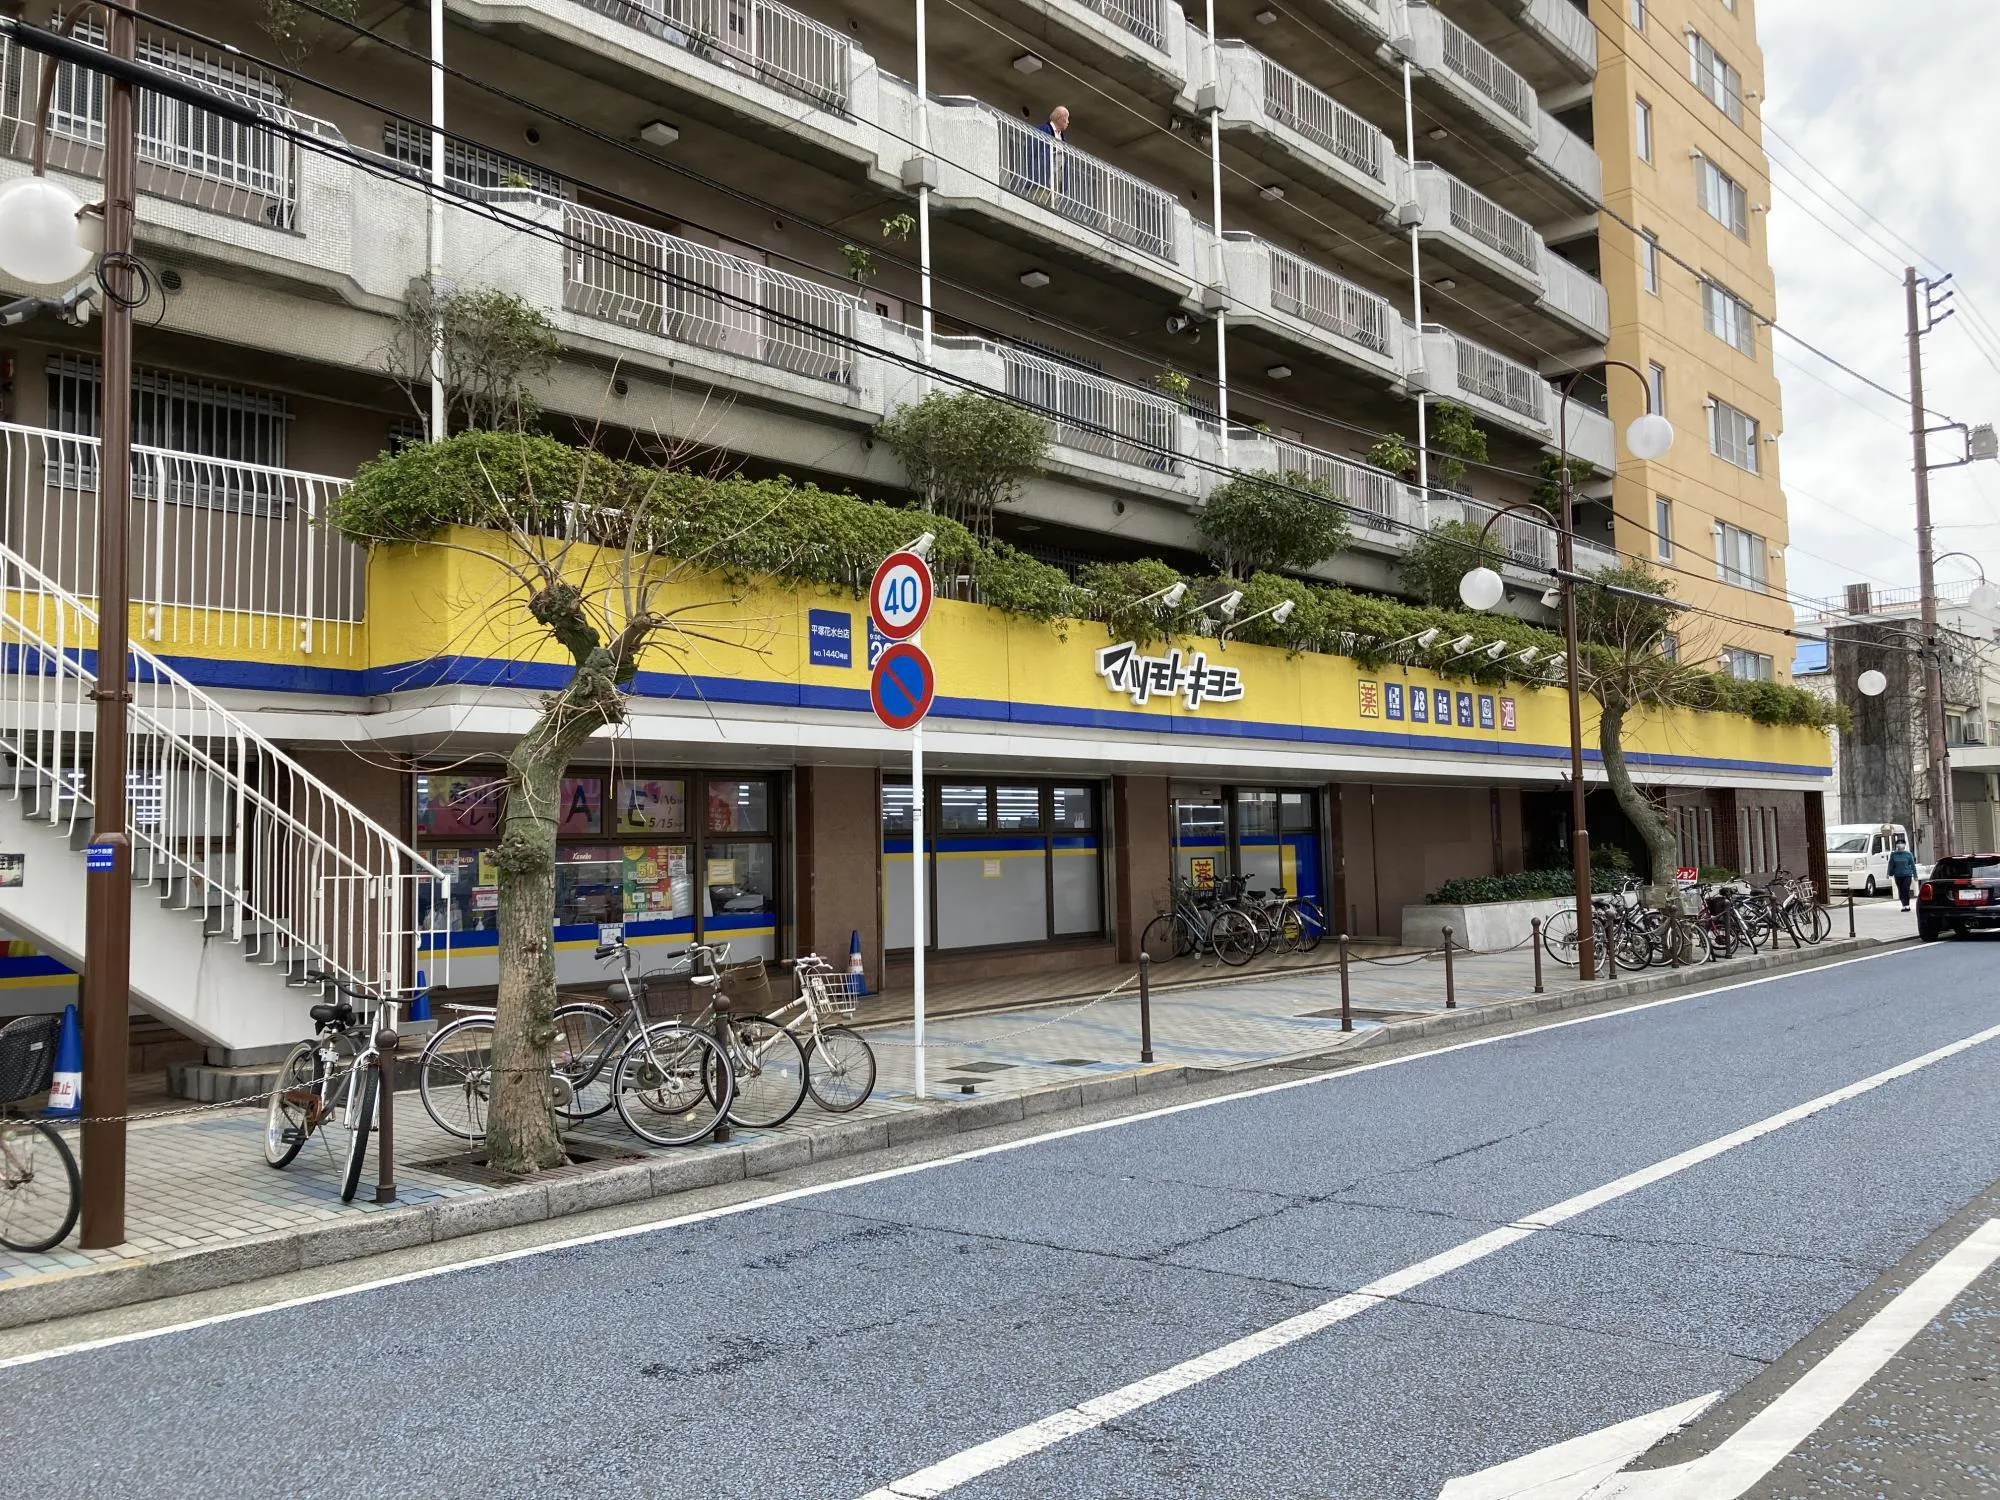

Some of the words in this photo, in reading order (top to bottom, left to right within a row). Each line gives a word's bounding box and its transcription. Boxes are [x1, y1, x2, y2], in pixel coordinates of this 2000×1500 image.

[884, 576, 917, 615] 40
[811, 624, 850, 640] 平塚花水台店
[870, 640, 894, 666] 2
[1100, 643, 1243, 707] マツモトキヨシ
[1360, 683, 1377, 715] 薬
[1501, 700, 1515, 727] 酒
